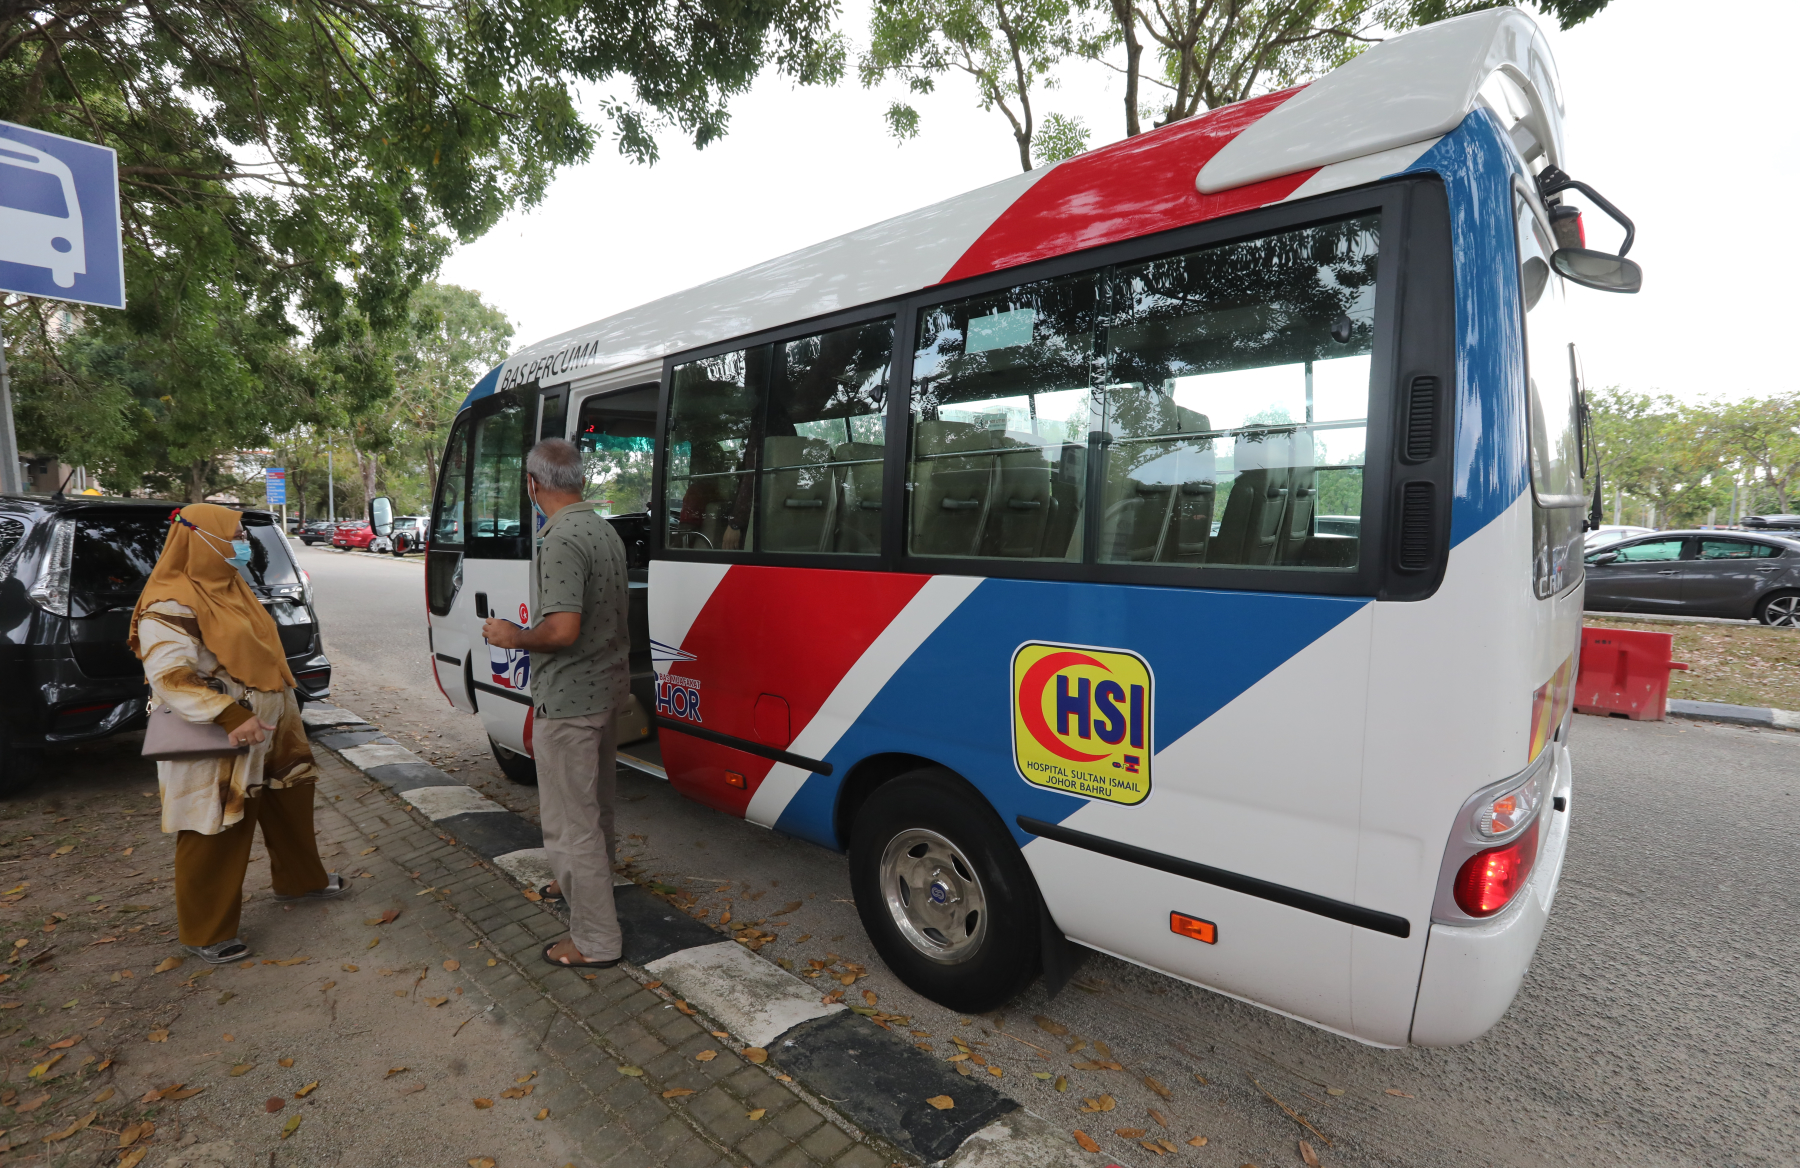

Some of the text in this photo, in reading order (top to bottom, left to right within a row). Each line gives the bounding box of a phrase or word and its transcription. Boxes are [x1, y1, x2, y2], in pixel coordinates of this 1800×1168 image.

[501, 339, 599, 391] BAS PERCUMA
[659, 673, 702, 690] BAS MUAFAKAT
[1056, 674, 1144, 750] HSI
[1027, 760, 1141, 793] HOSPITAL SULTAN ISMAIL
[1045, 775, 1112, 797] JOHOR BAHRU
